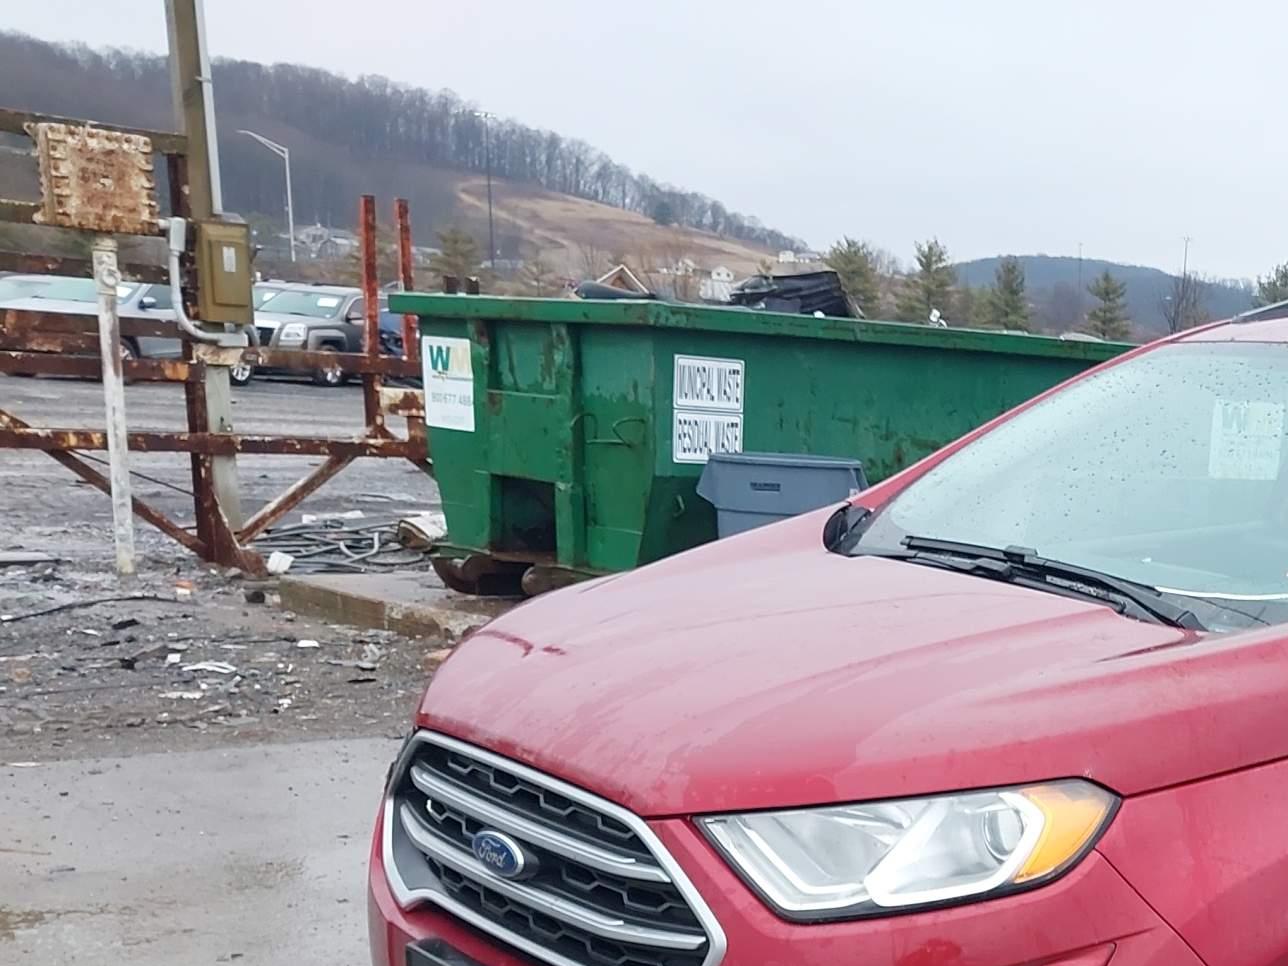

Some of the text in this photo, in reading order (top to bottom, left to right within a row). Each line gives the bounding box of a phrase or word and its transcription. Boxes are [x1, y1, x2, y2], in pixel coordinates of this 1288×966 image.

[717, 368, 740, 403] WASTE
[678, 418, 738, 454] RESIDUAL WASTE
[479, 838, 507, 869] Ford
